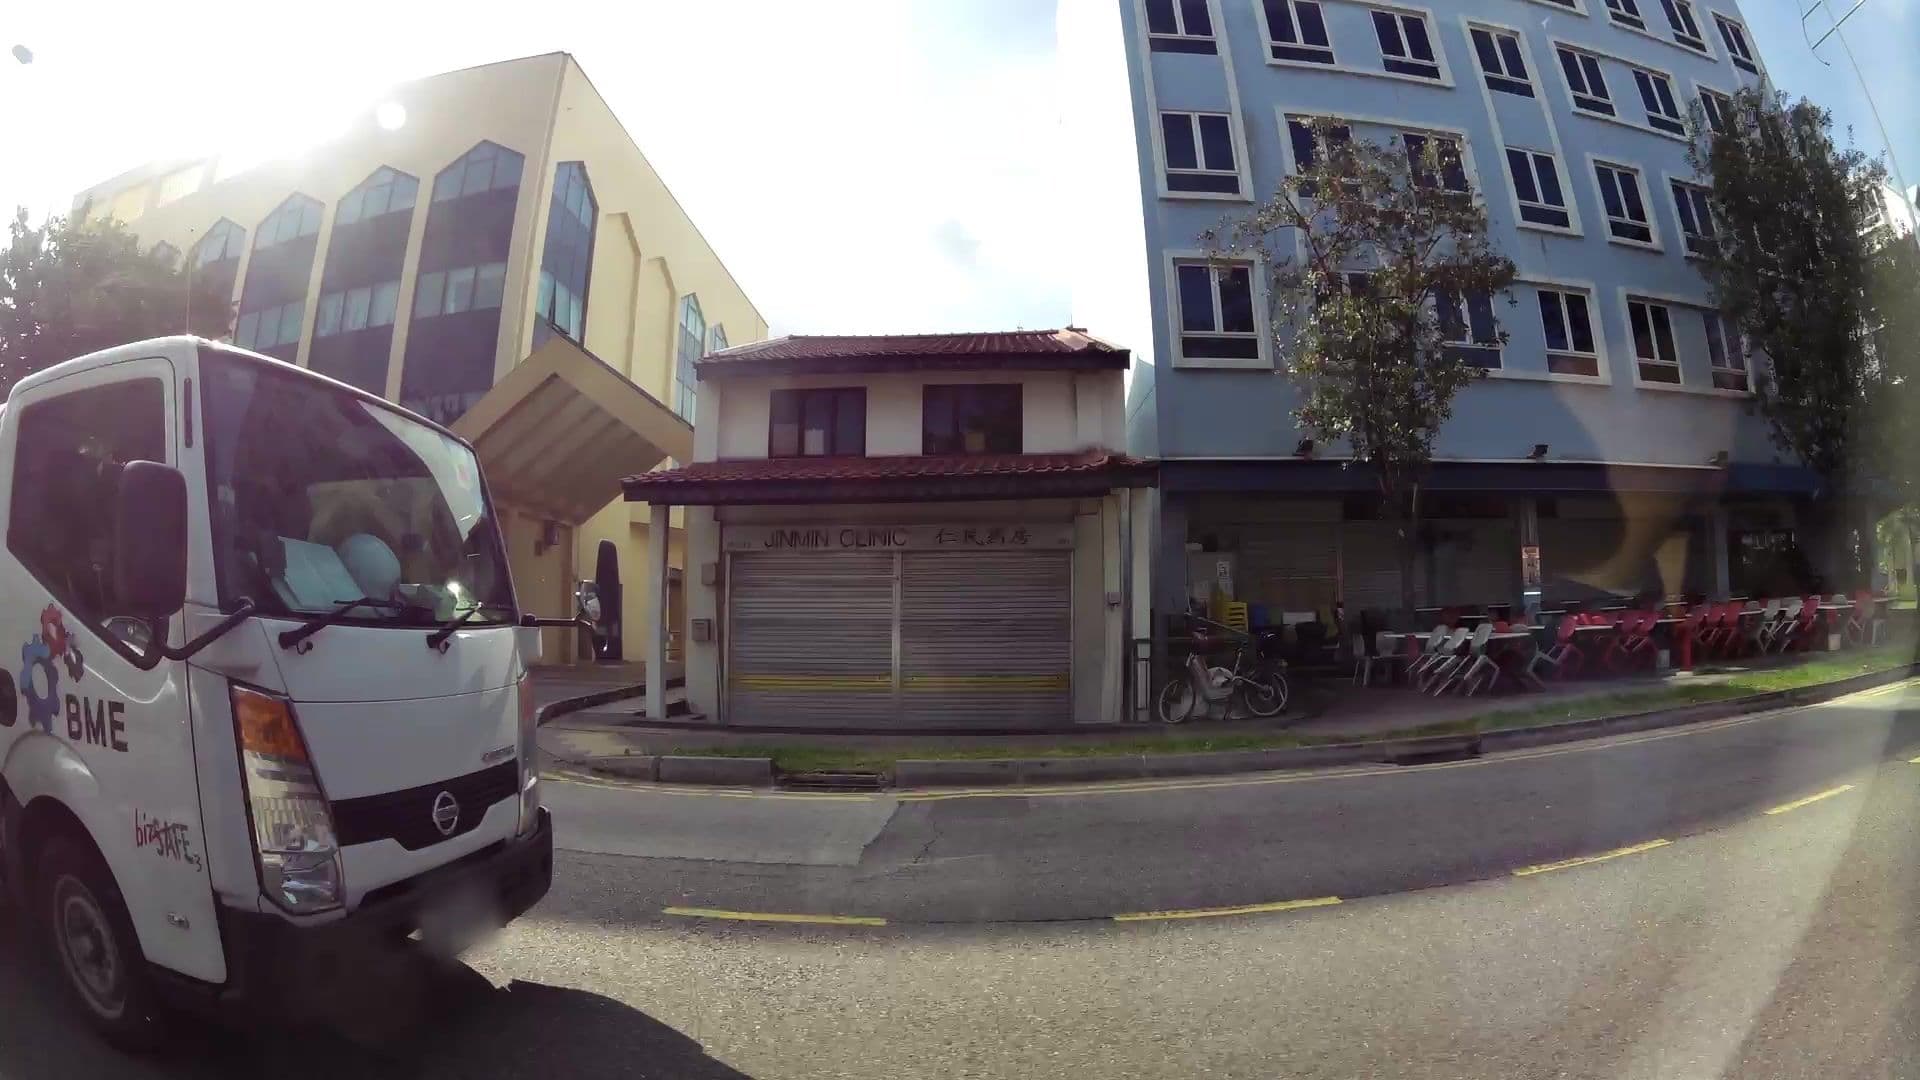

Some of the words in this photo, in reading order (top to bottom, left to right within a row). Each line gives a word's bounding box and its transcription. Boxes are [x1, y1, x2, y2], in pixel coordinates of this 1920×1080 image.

[764, 529, 830, 548] JINMIN
[839, 528, 906, 547] CLINIC
[65, 694, 128, 752] BME
